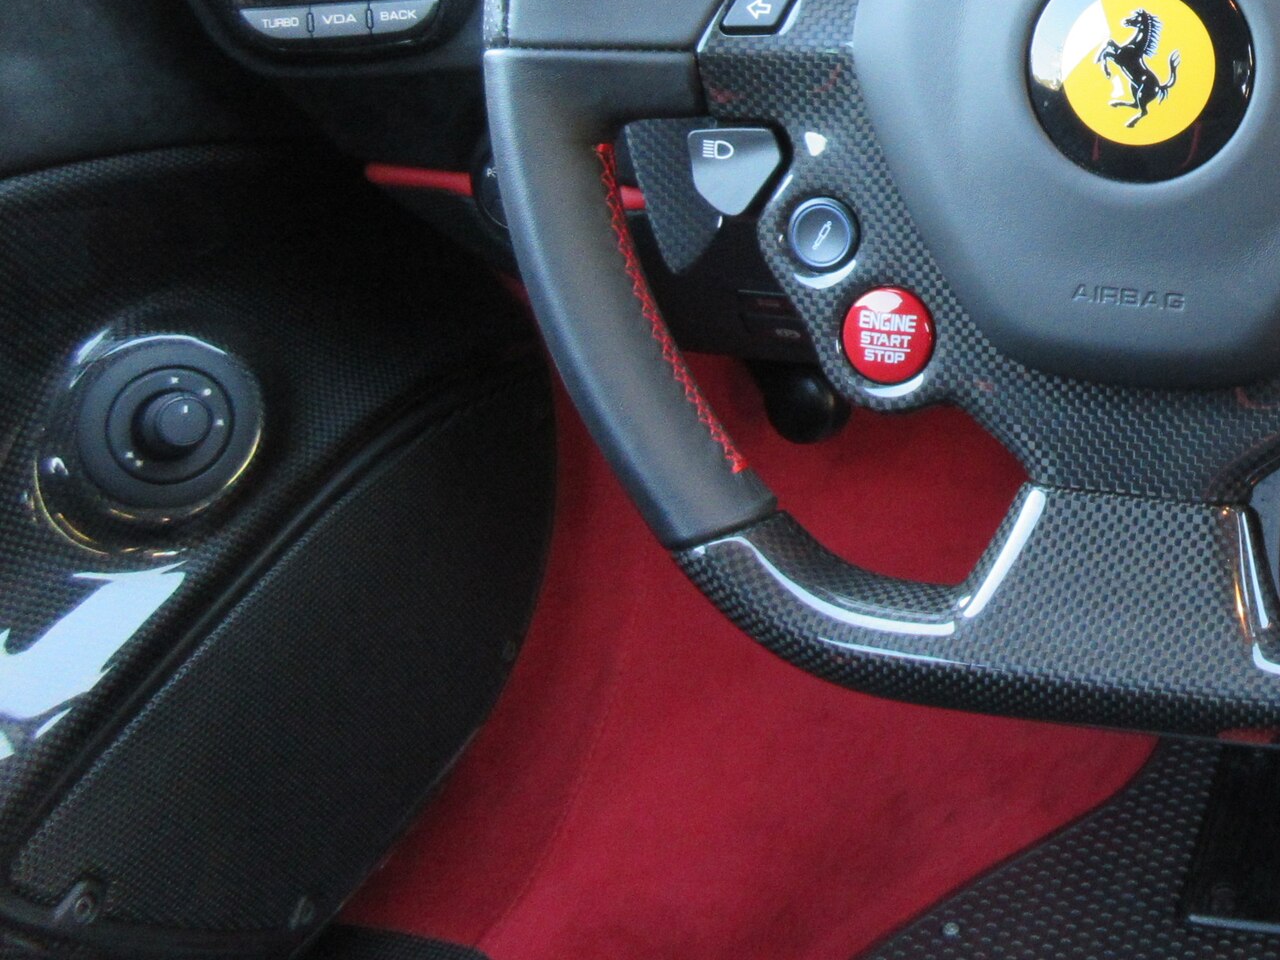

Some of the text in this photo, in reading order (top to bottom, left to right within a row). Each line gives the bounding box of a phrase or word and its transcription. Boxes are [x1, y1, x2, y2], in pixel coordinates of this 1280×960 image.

[261, 16, 300, 29] TURBO
[321, 12, 357, 25] VDA
[380, 9, 417, 21] BACK
[1071, 283, 1186, 312] AIRBAG
[859, 309, 918, 333] ENGINE
[860, 331, 912, 349] START
[864, 349, 905, 365] STOP
